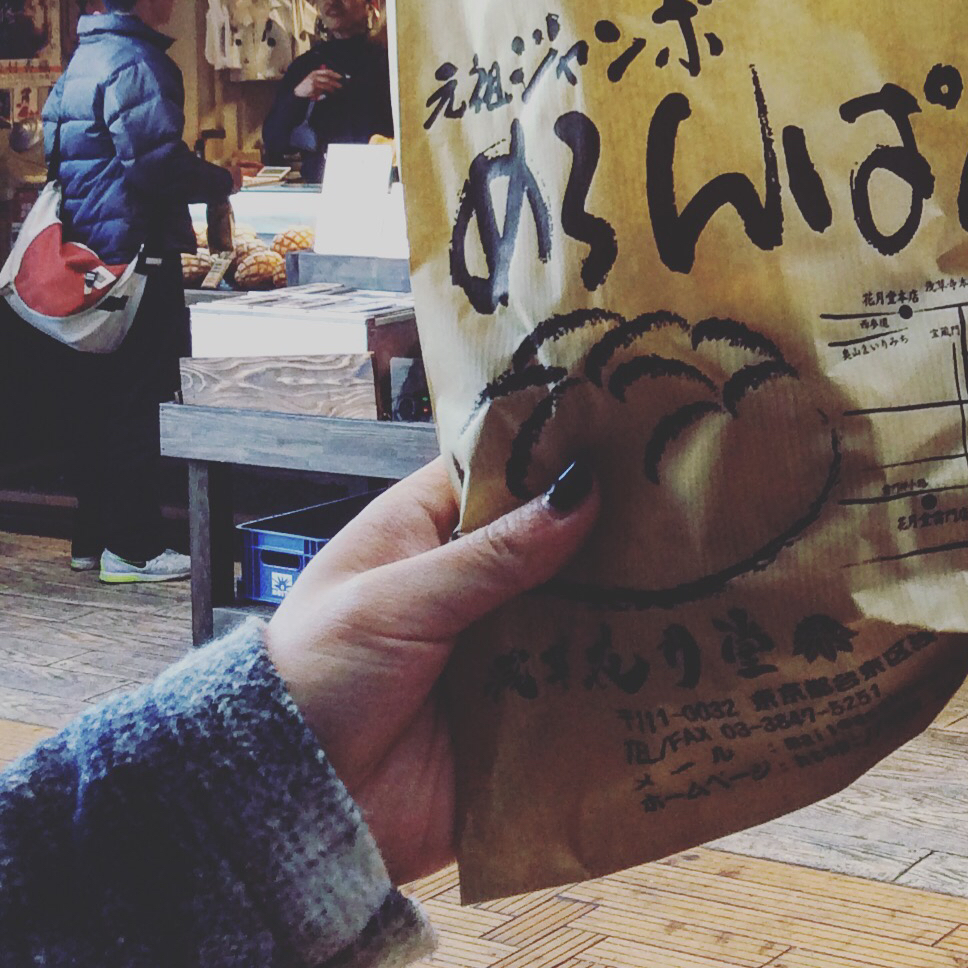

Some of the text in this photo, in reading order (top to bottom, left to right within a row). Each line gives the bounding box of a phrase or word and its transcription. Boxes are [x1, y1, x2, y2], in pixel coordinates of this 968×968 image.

[862, 289, 919, 307] 花月堂本店
